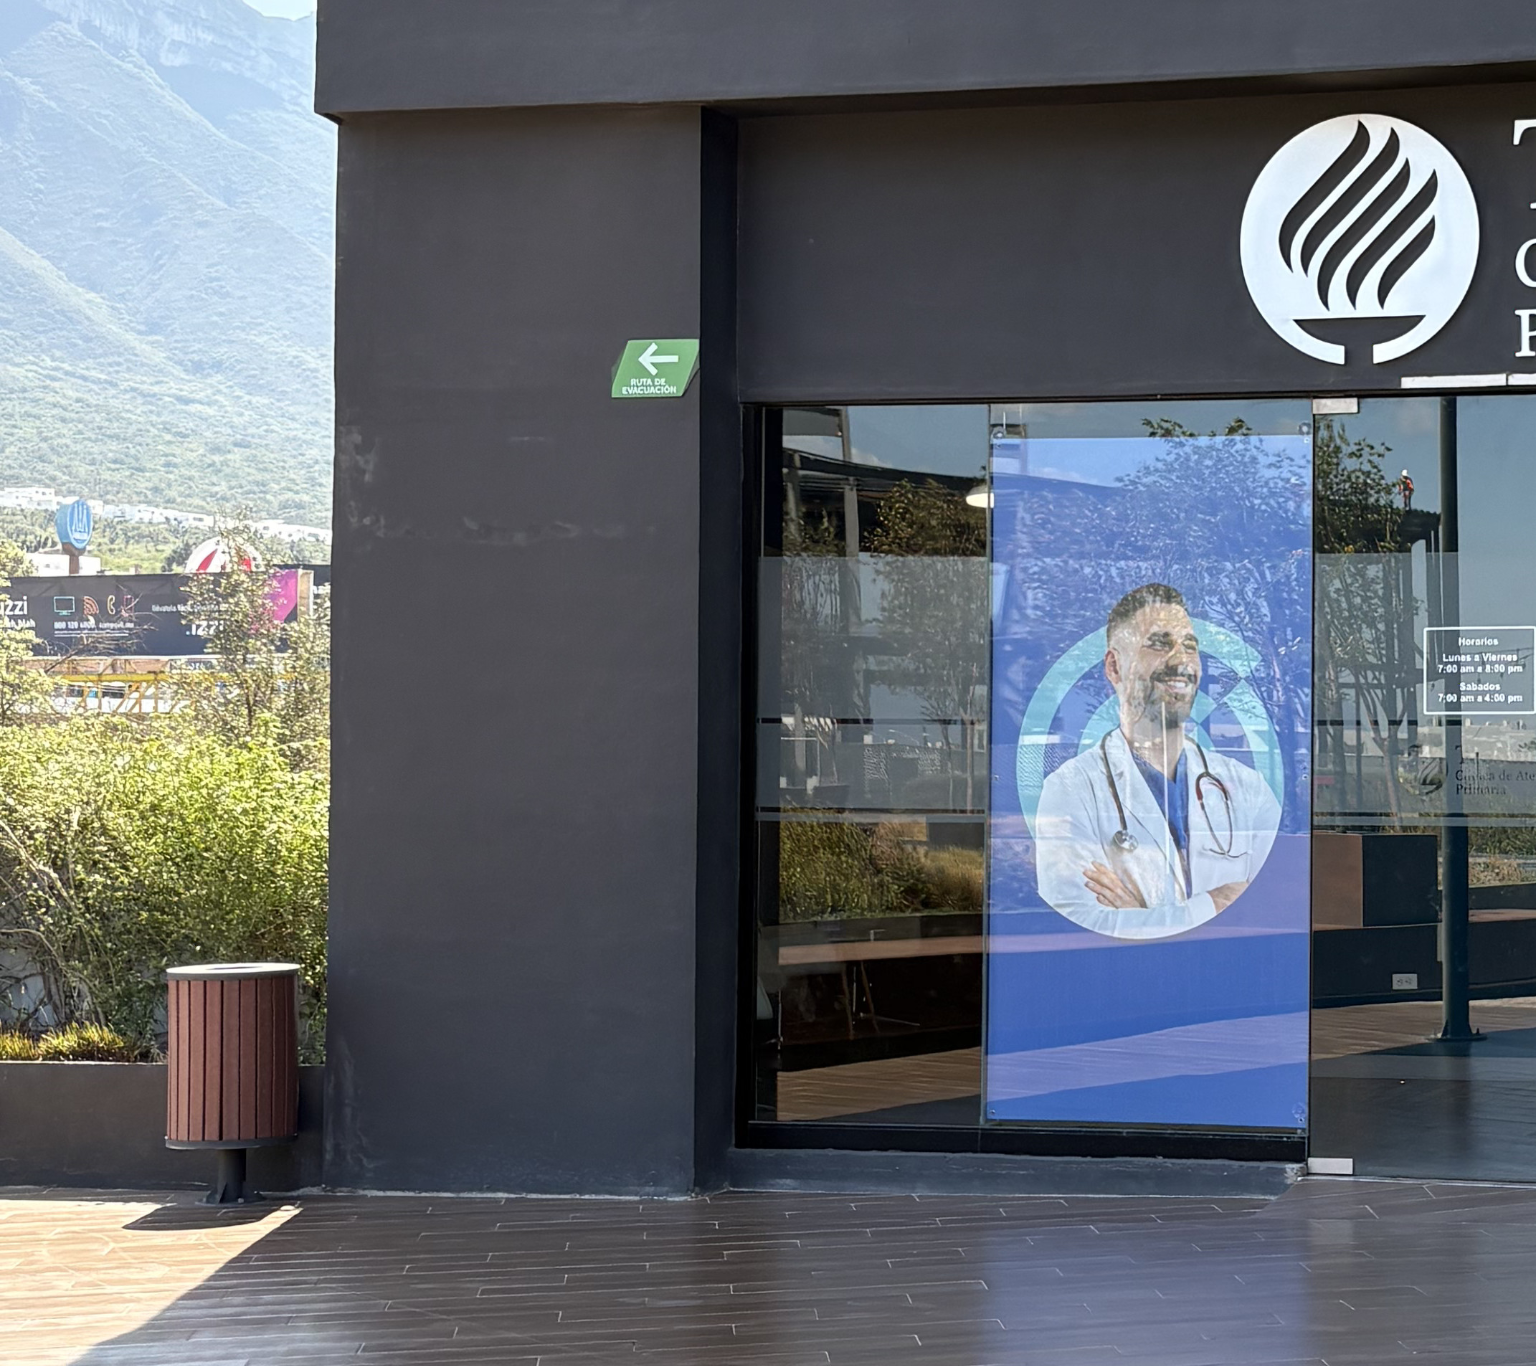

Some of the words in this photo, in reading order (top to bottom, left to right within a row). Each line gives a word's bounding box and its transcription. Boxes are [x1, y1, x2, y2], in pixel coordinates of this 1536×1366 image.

[630, 378, 653, 386] RUTA
[622, 385, 677, 394] EVACUACIÓN
[1459, 637, 1498, 646] Horarios
[1443, 654, 1471, 662] Lunes
[1482, 653, 1518, 662] Viernes
[1438, 665, 1458, 673] 7:00
[1508, 665, 1523, 674] pm
[1438, 694, 1458, 703] 7:00
[1484, 693, 1505, 702] 4:00
[1508, 695, 1523, 704] pm
